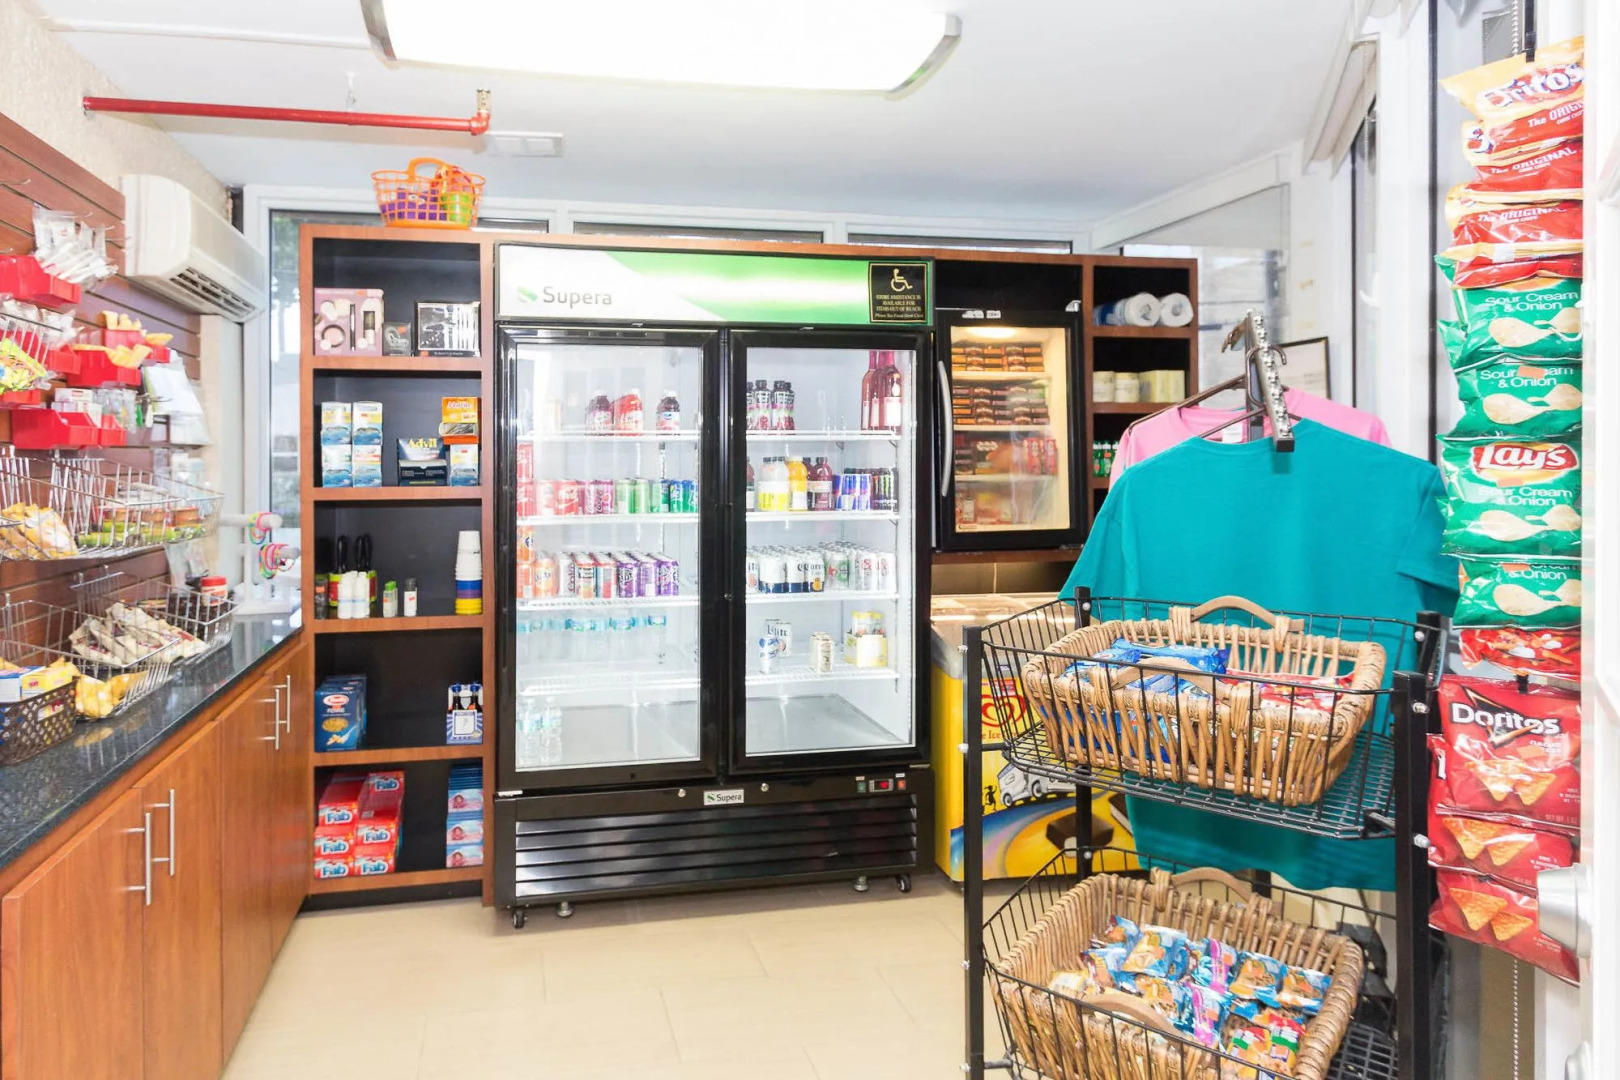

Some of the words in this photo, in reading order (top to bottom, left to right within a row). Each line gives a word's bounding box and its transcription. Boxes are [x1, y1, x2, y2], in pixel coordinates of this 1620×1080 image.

[1481, 64, 1583, 107] Fritos
[1527, 116, 1547, 128] The
[1490, 166, 1509, 174] The
[1512, 147, 1577, 170] ORIGINAL
[1478, 214, 1496, 222] The
[1500, 207, 1567, 220] ORIGINAL
[543, 286, 612, 309] Supera
[1485, 296, 1520, 307] Sour
[1525, 292, 1578, 302] Cream
[1504, 303, 1513, 312] &
[1516, 302, 1562, 311] Onion
[1480, 369, 1516, 380] Sour
[1498, 378, 1508, 388] &
[1510, 377, 1557, 387] Onion
[408, 437, 437, 448] Advil
[1479, 445, 1567, 470] Lay's
[1519, 487, 1573, 497] Cream
[1508, 495, 1556, 506] Onion
[1521, 567, 1567, 580] Onion
[1451, 702, 1561, 735] Doritos
[375, 779, 398, 790] Fab
[716, 793, 742, 802] Supera
[326, 811, 351, 823] Fab
[365, 829, 389, 842] Fab
[322, 841, 347, 853] Fab
[322, 865, 346, 876] Fab
[362, 861, 387, 873] Fab
